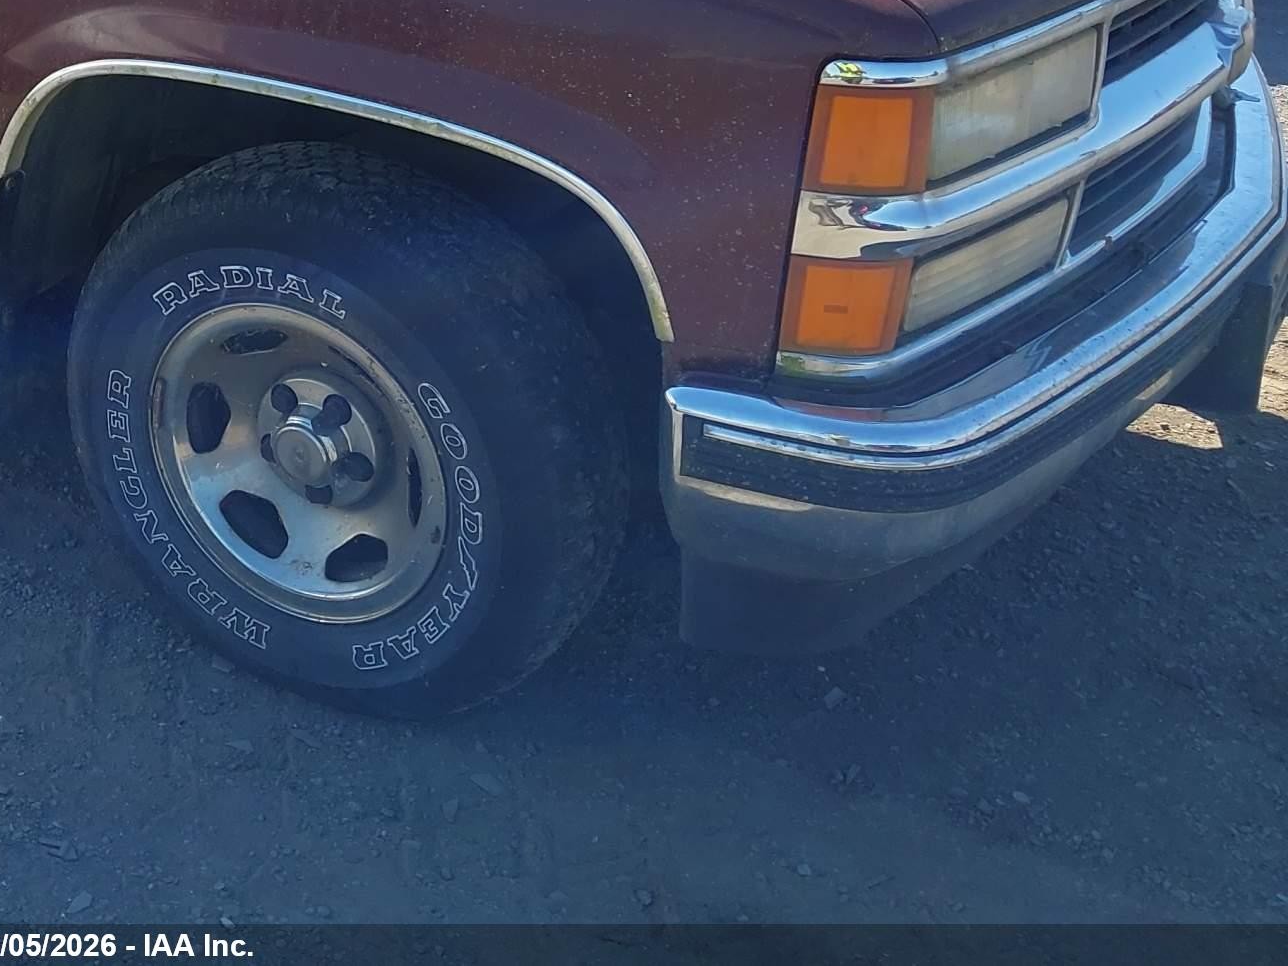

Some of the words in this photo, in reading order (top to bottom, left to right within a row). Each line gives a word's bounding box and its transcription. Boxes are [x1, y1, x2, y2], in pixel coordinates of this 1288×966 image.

[152, 264, 347, 321] RADIAL
[106, 369, 272, 650] WRANGLER
[352, 382, 484, 671] GOODYEAR
